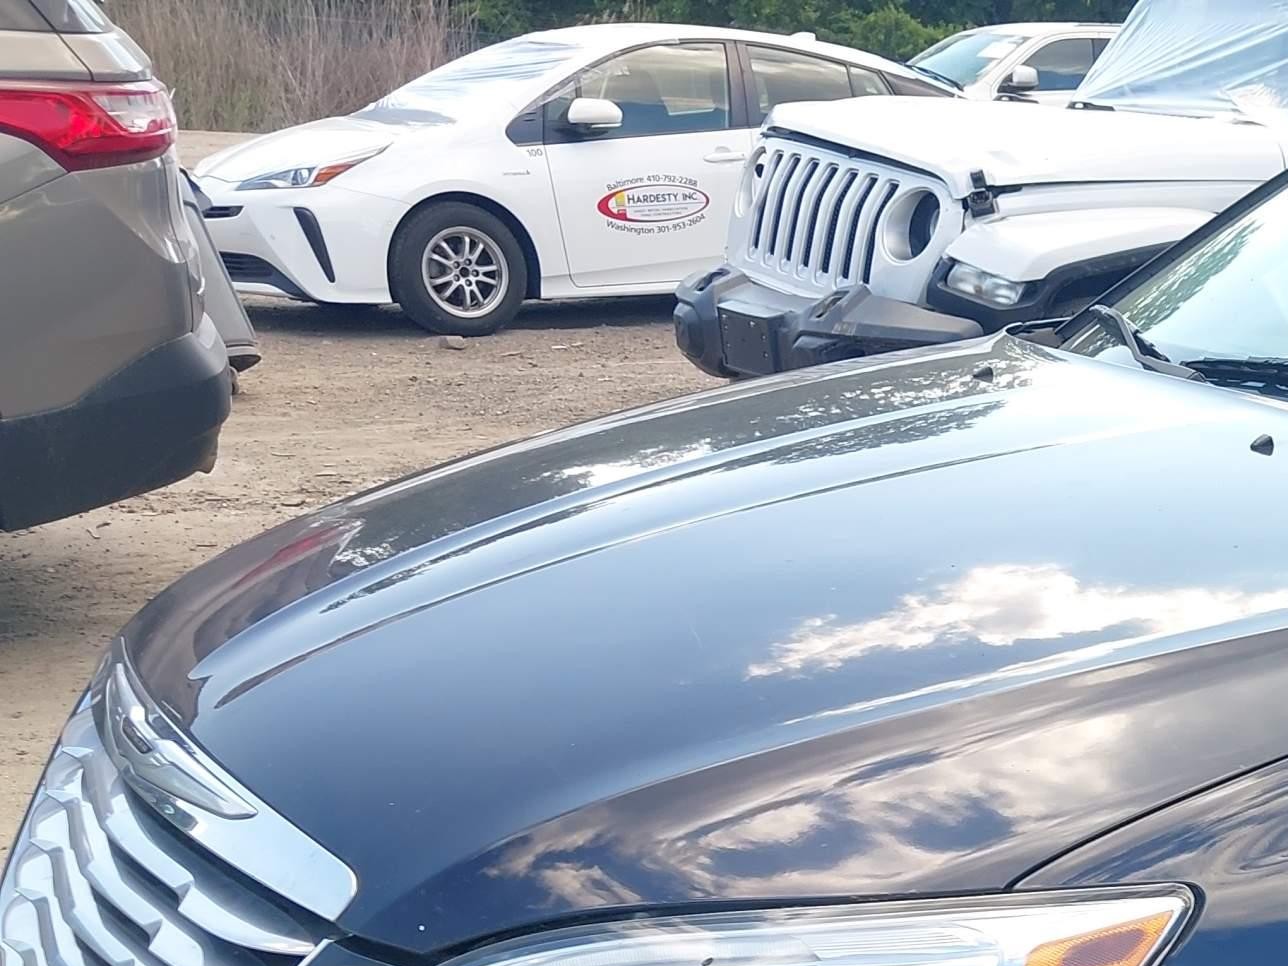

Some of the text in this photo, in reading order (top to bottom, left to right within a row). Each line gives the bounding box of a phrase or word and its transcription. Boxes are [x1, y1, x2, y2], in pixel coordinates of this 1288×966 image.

[526, 148, 543, 157] 100
[606, 174, 698, 191] Baltimore 410-792-2288
[627, 192, 678, 204] HARDESTY
[606, 214, 706, 235] Washington 301-953-2604
